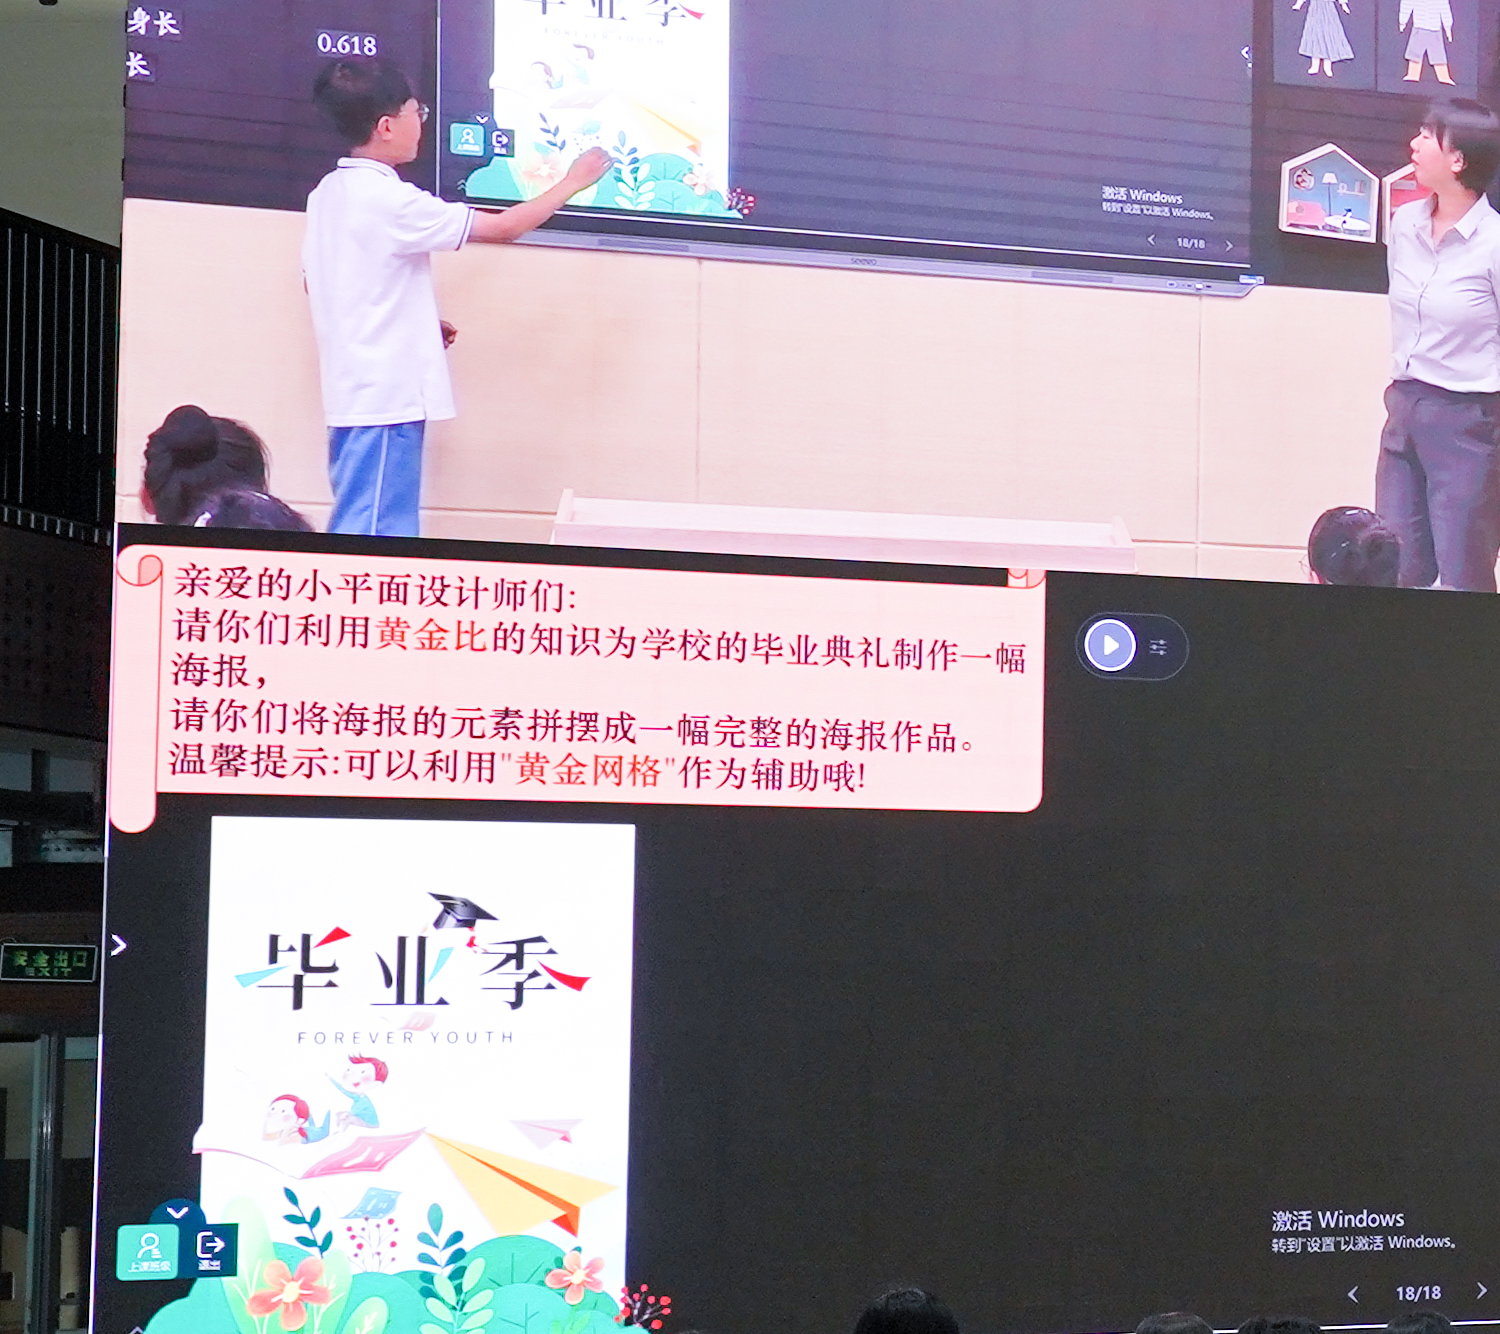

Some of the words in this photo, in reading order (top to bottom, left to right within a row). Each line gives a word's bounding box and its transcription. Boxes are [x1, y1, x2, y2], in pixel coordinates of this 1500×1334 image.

[128, 7, 180, 37] 身长
[317, 32, 377, 56] 0.618
[1130, 188, 1183, 205] Windows
[173, 563, 577, 614] 亲爱的小平面设计师们:
[172, 606, 1027, 677] 请你们利用黄金比的知识为学校的毕业典礼制作一幅
[169, 695, 975, 756] 请你们将海报的元素拼摆成一幅完整的海报作品。
[234, 925, 592, 1011] 毕业季
[297, 1030, 414, 1045] FOREVER
[430, 1030, 516, 1045] YOUTH
[1272, 1210, 1313, 1232] 激活
[1317, 1210, 1405, 1228] Windows
[1396, 1285, 1442, 1303] 18/18
